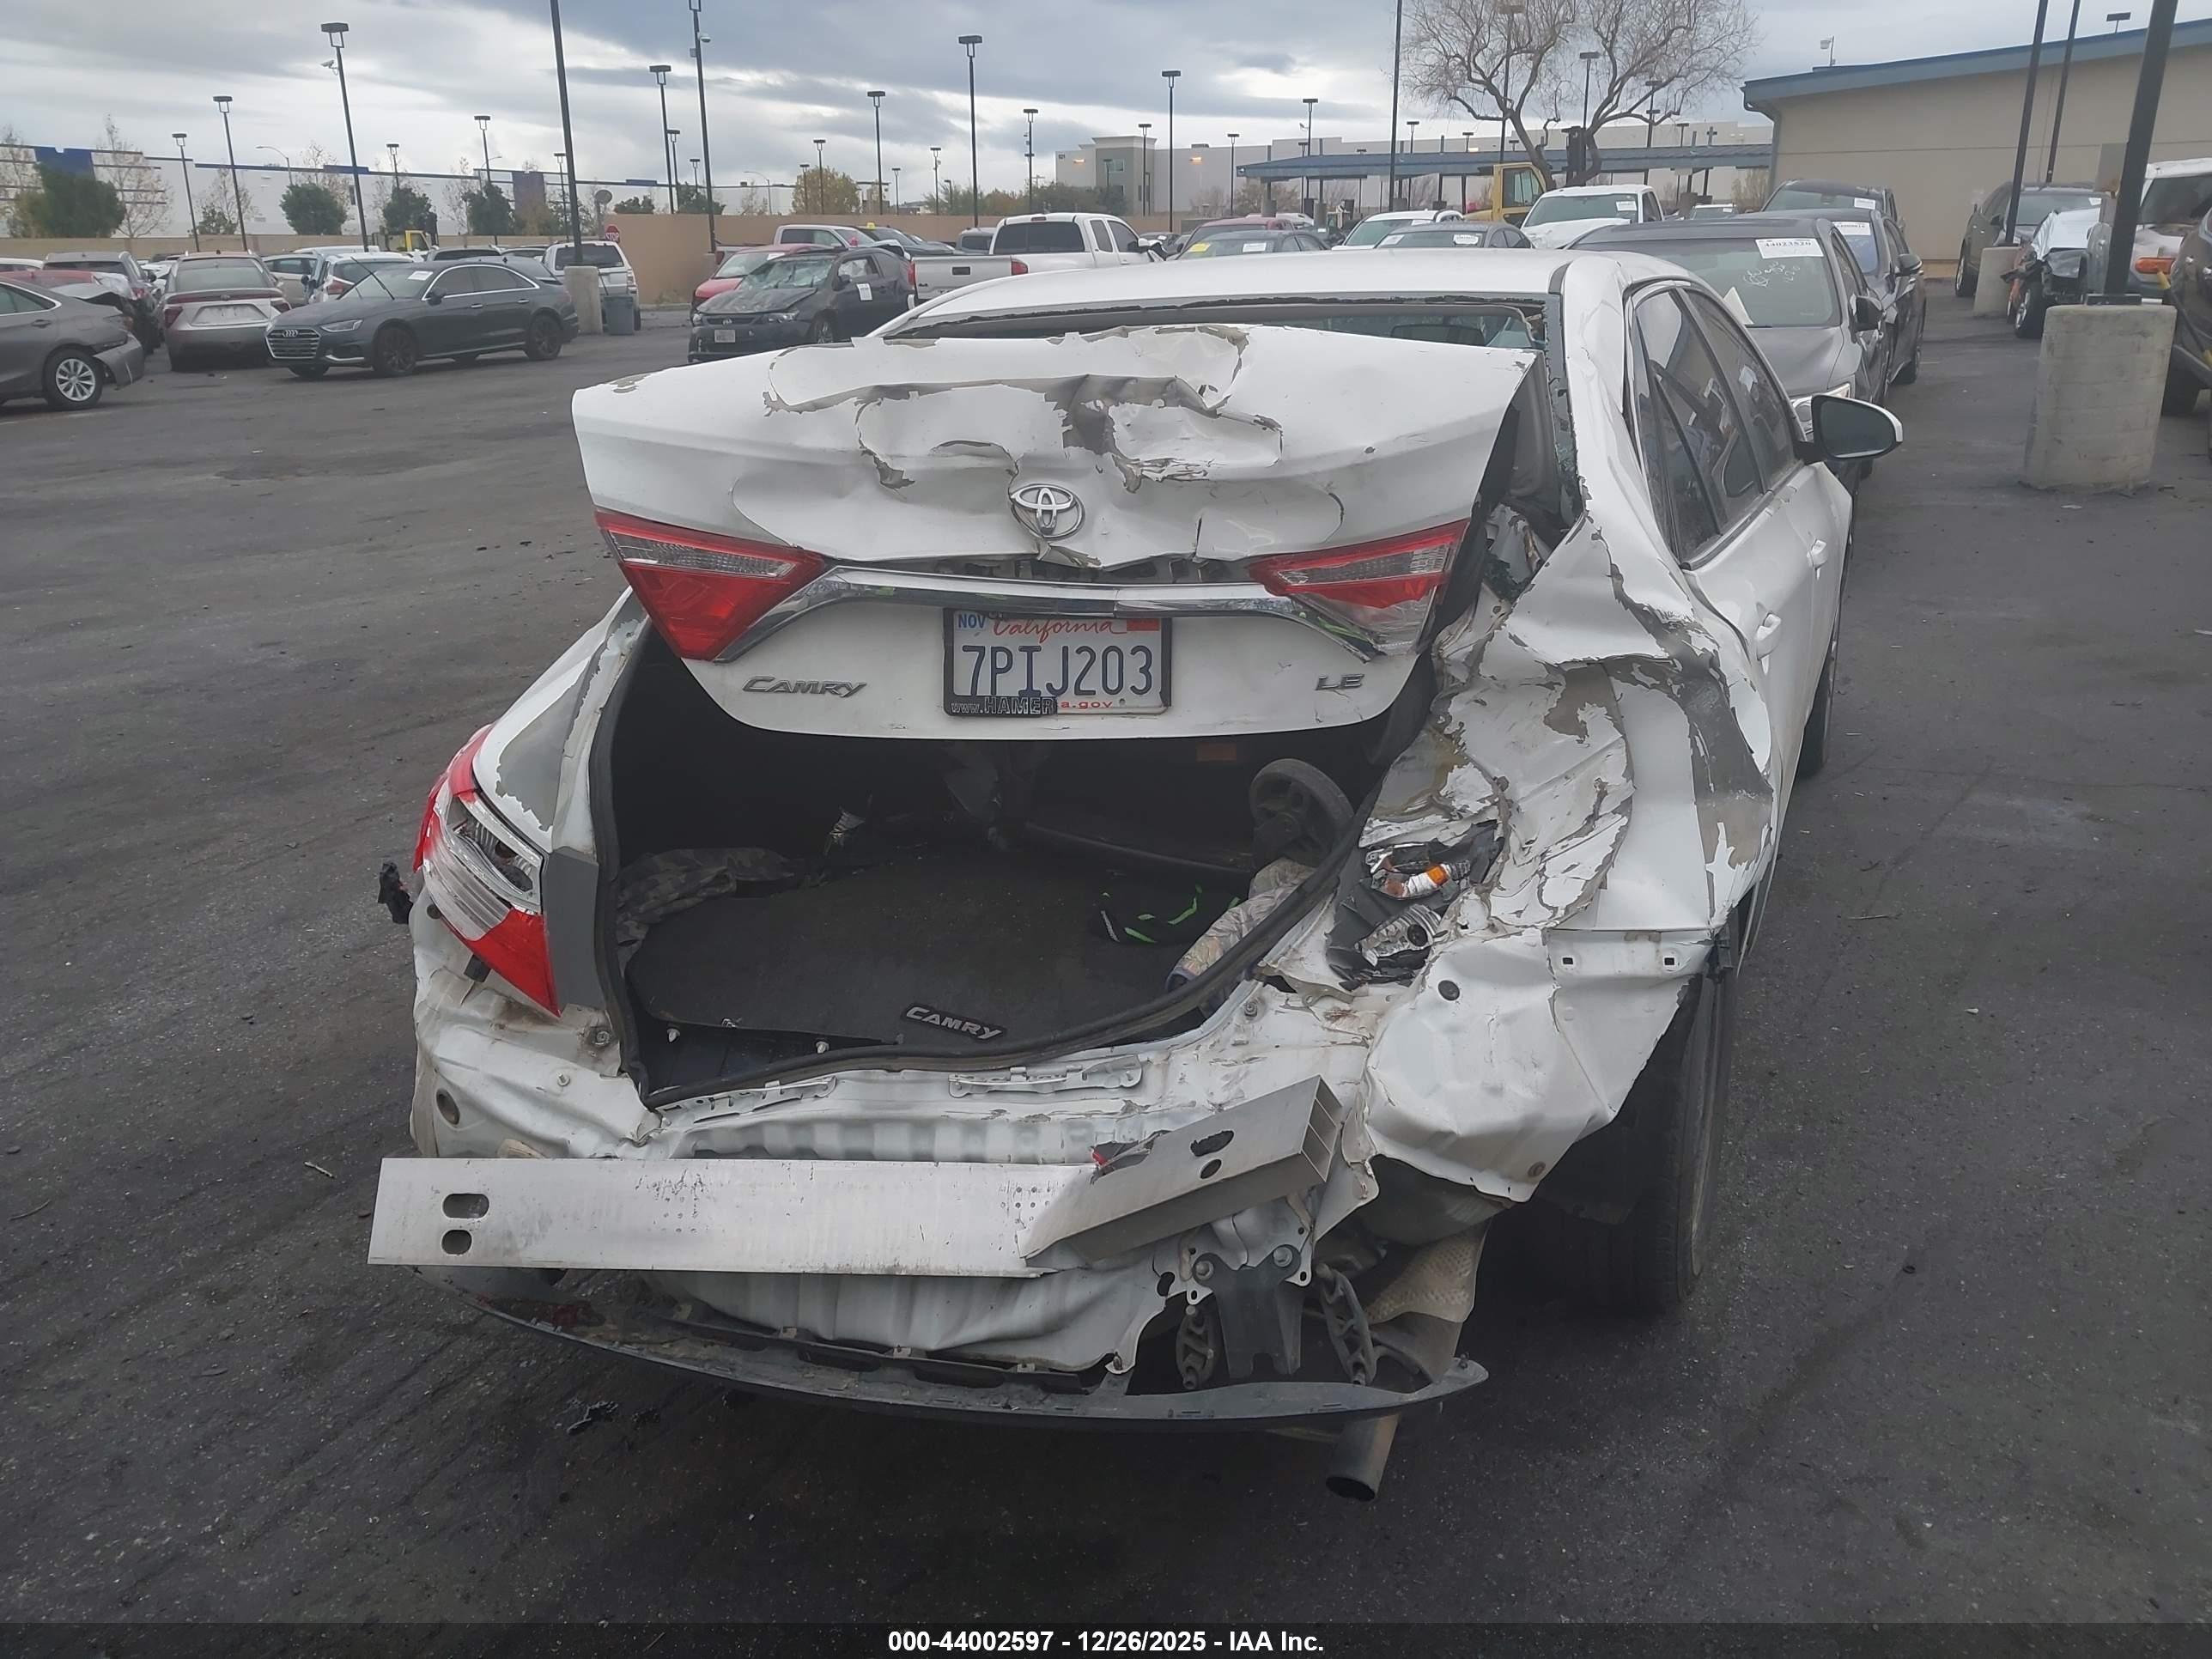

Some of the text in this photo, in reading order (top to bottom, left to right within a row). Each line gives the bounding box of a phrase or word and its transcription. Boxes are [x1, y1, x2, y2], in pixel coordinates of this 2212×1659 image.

[605, 232, 619, 241] STOP
[957, 613, 1127, 643] NOV California
[962, 645, 1152, 697] 7PIJ203
[1315, 674, 1364, 691] LE
[742, 675, 867, 698] CAMRY
[906, 1006, 1003, 1040] CAMRY
